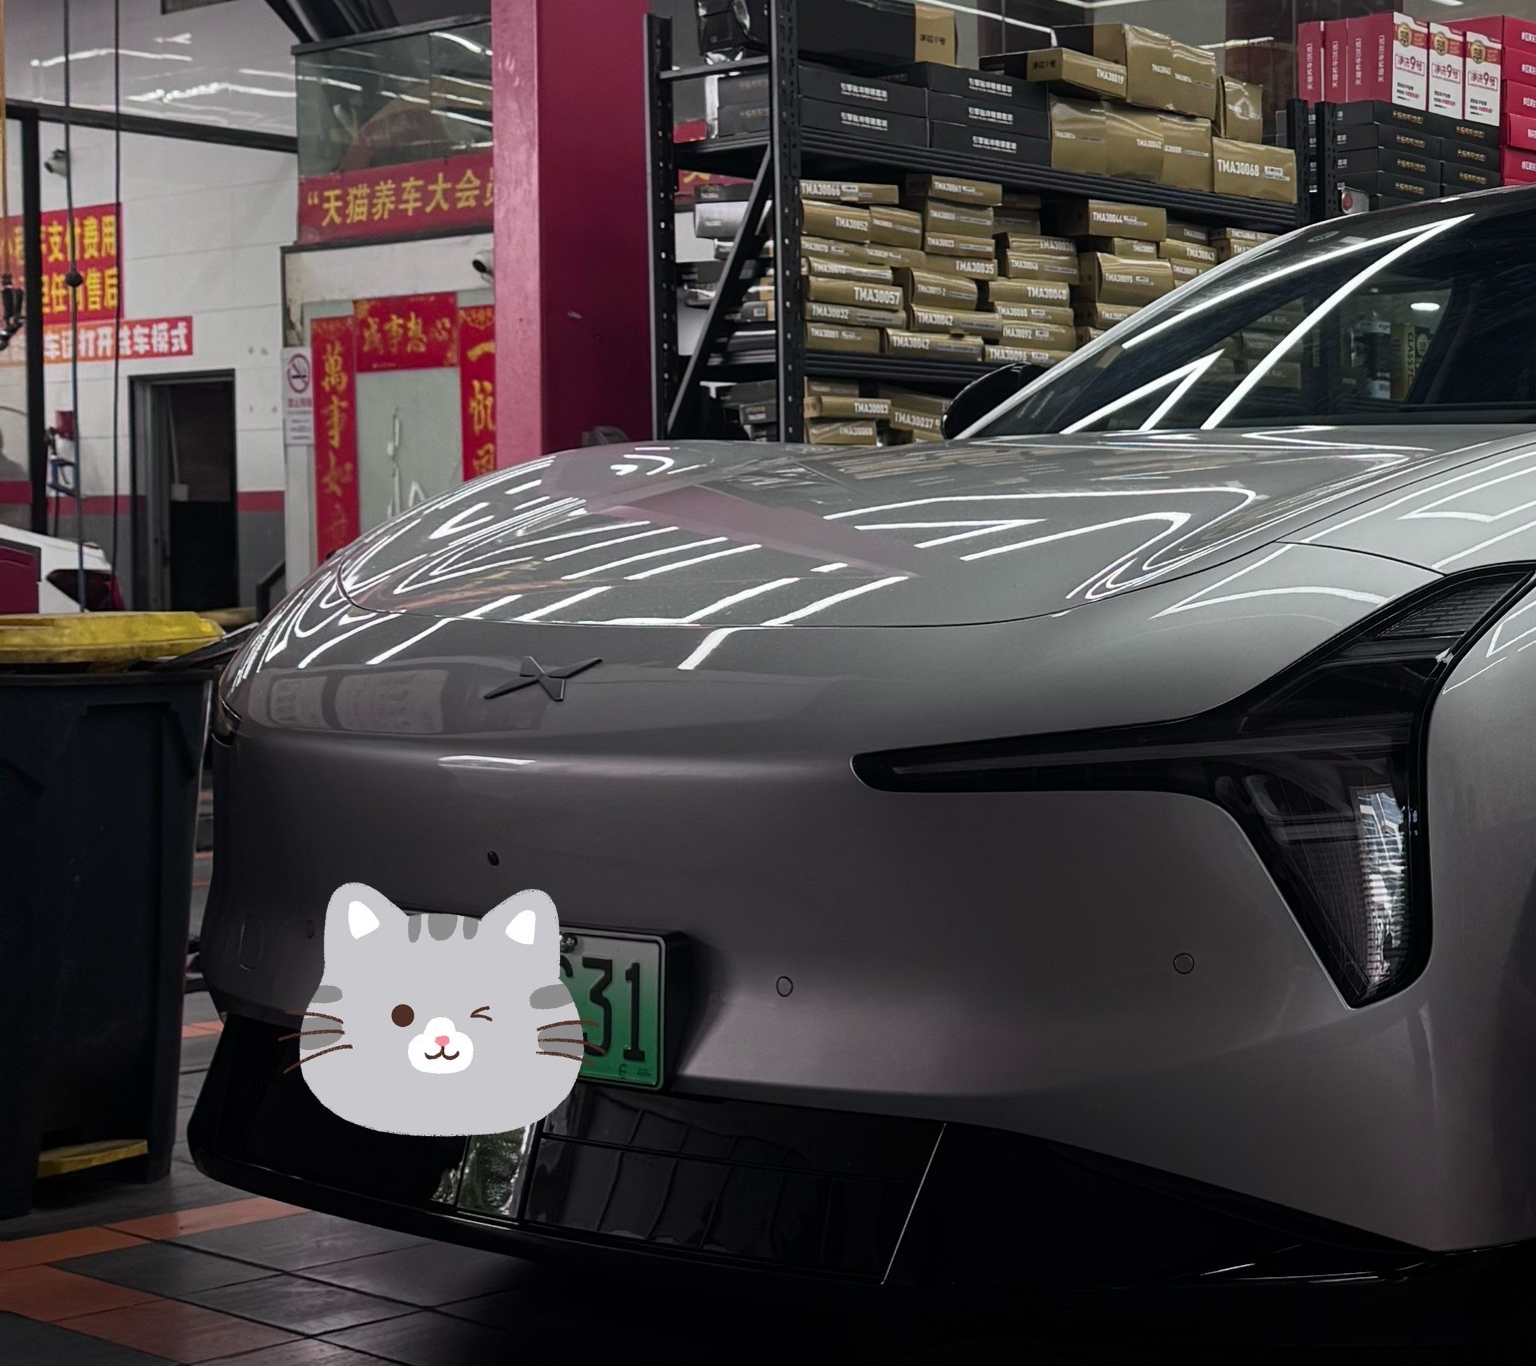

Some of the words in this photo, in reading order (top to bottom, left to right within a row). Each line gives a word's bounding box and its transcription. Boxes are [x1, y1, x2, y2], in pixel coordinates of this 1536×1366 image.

[1216, 158, 1260, 178] TMA30068
[41, 215, 116, 263] 支付费用
[854, 286, 900, 305] TMA30057
[894, 411, 934, 429] TMA30037
[560, 954, 646, 1062] 31
